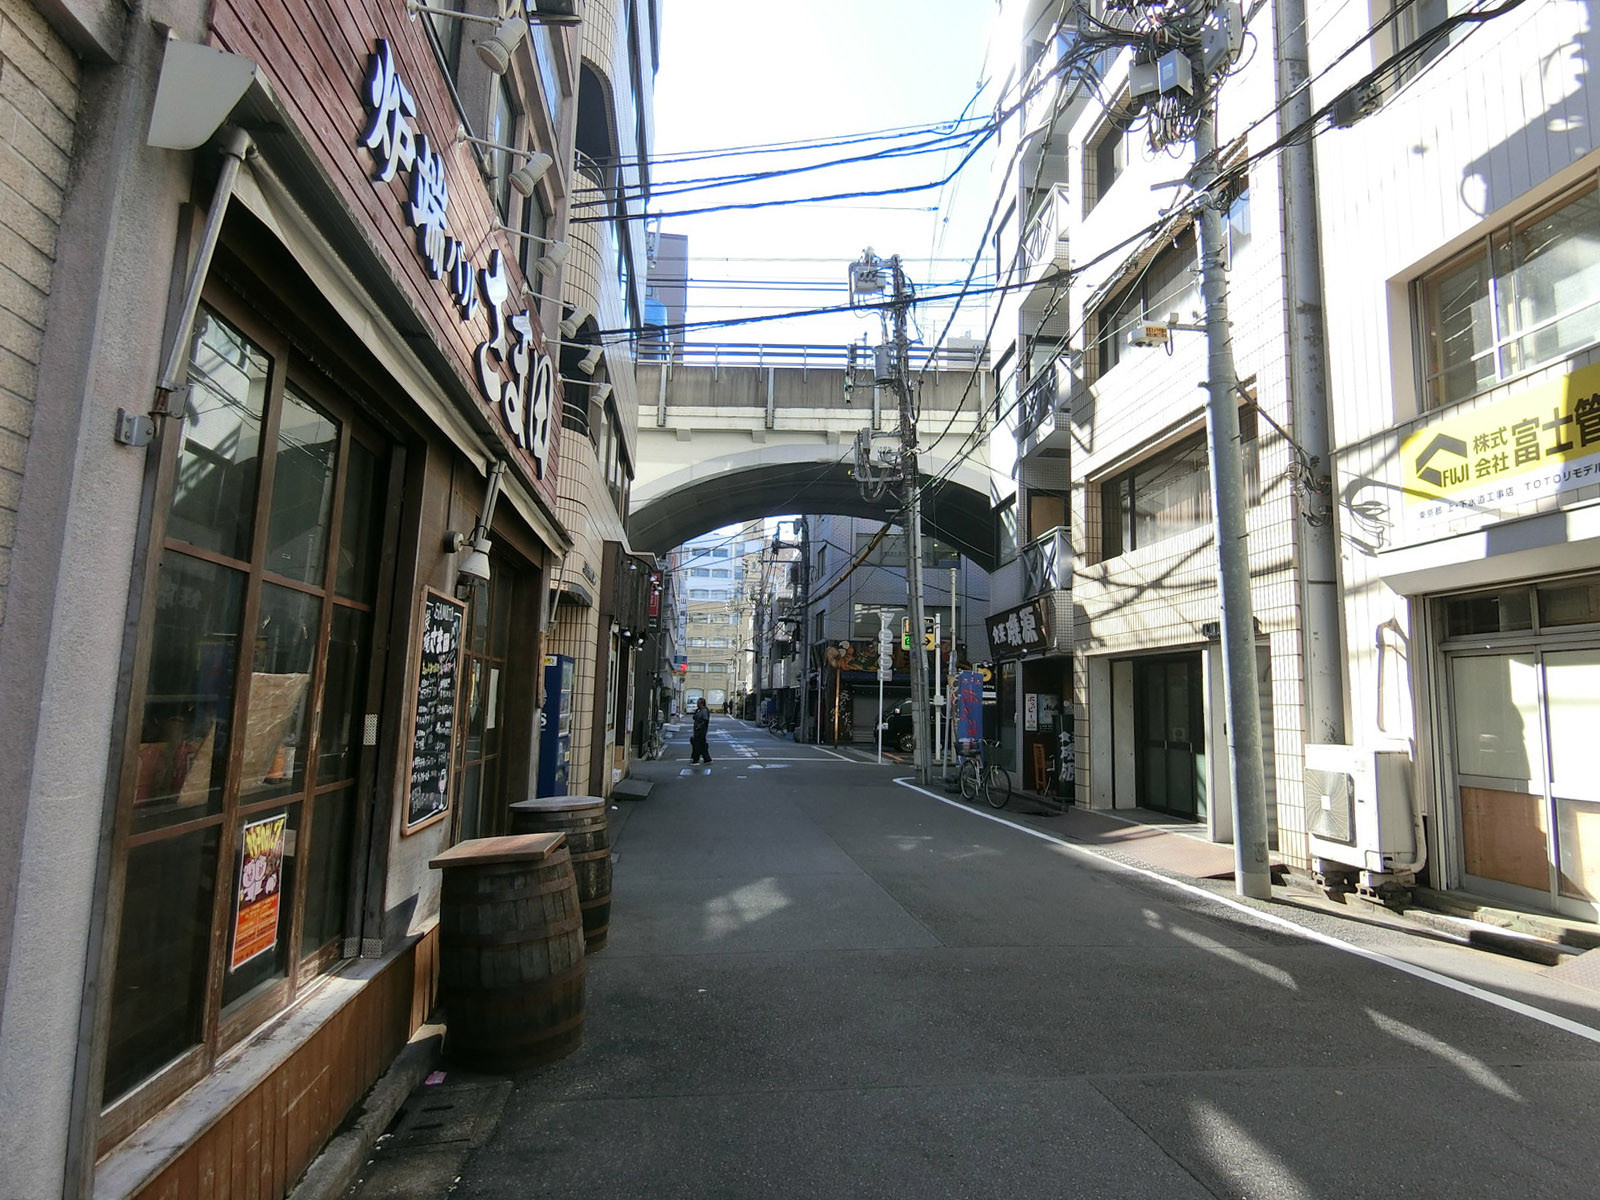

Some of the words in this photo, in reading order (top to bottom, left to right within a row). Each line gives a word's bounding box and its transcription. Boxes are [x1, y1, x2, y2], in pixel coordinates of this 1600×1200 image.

[1473, 427, 1508, 454] 株式
[1442, 463, 1470, 488] FUJI
[1474, 452, 1509, 480] 会社
[1026, 695, 1036, 719] ホッピー
